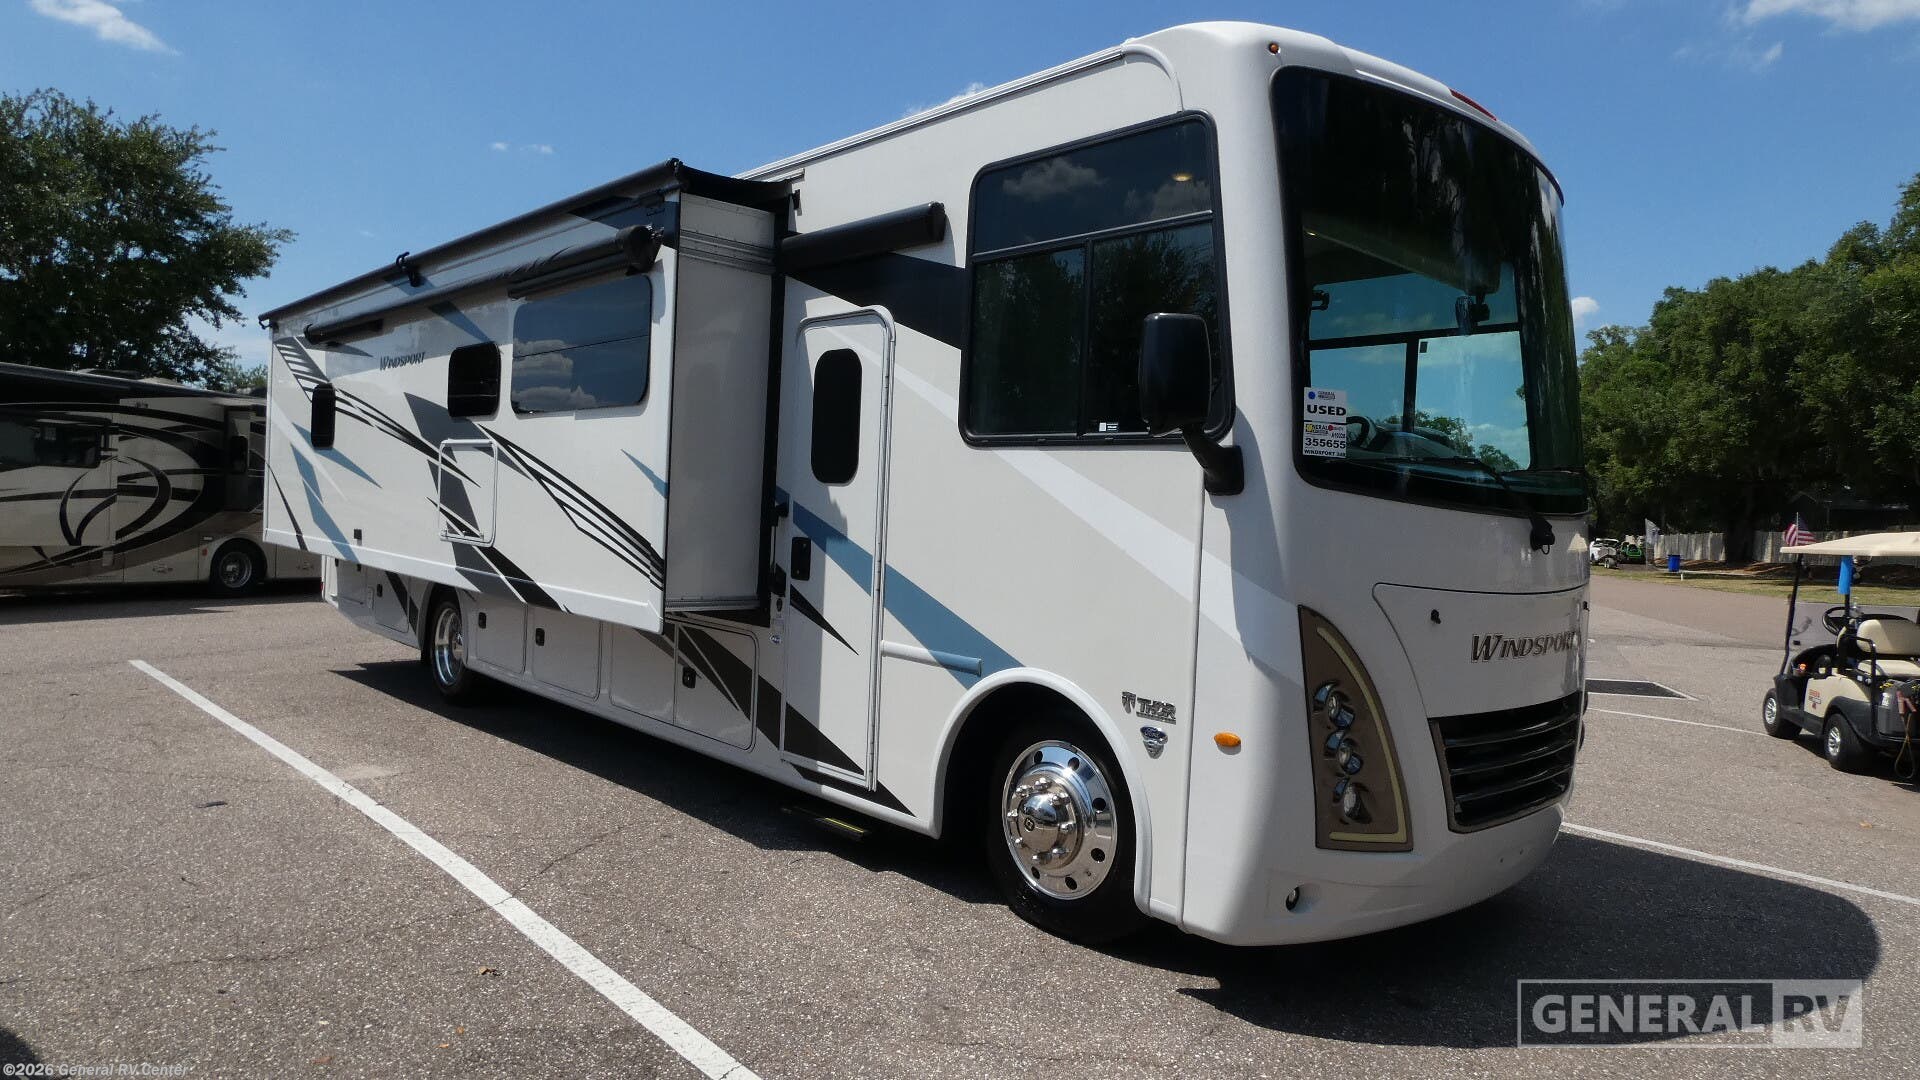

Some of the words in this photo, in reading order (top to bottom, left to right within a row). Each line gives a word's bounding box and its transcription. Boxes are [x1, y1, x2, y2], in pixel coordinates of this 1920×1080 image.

[380, 351, 426, 371] WINDSPORT
[1307, 405, 1346, 415] USED
[1305, 438, 1345, 448] 355655
[1471, 630, 1578, 663] WINDSPORT
